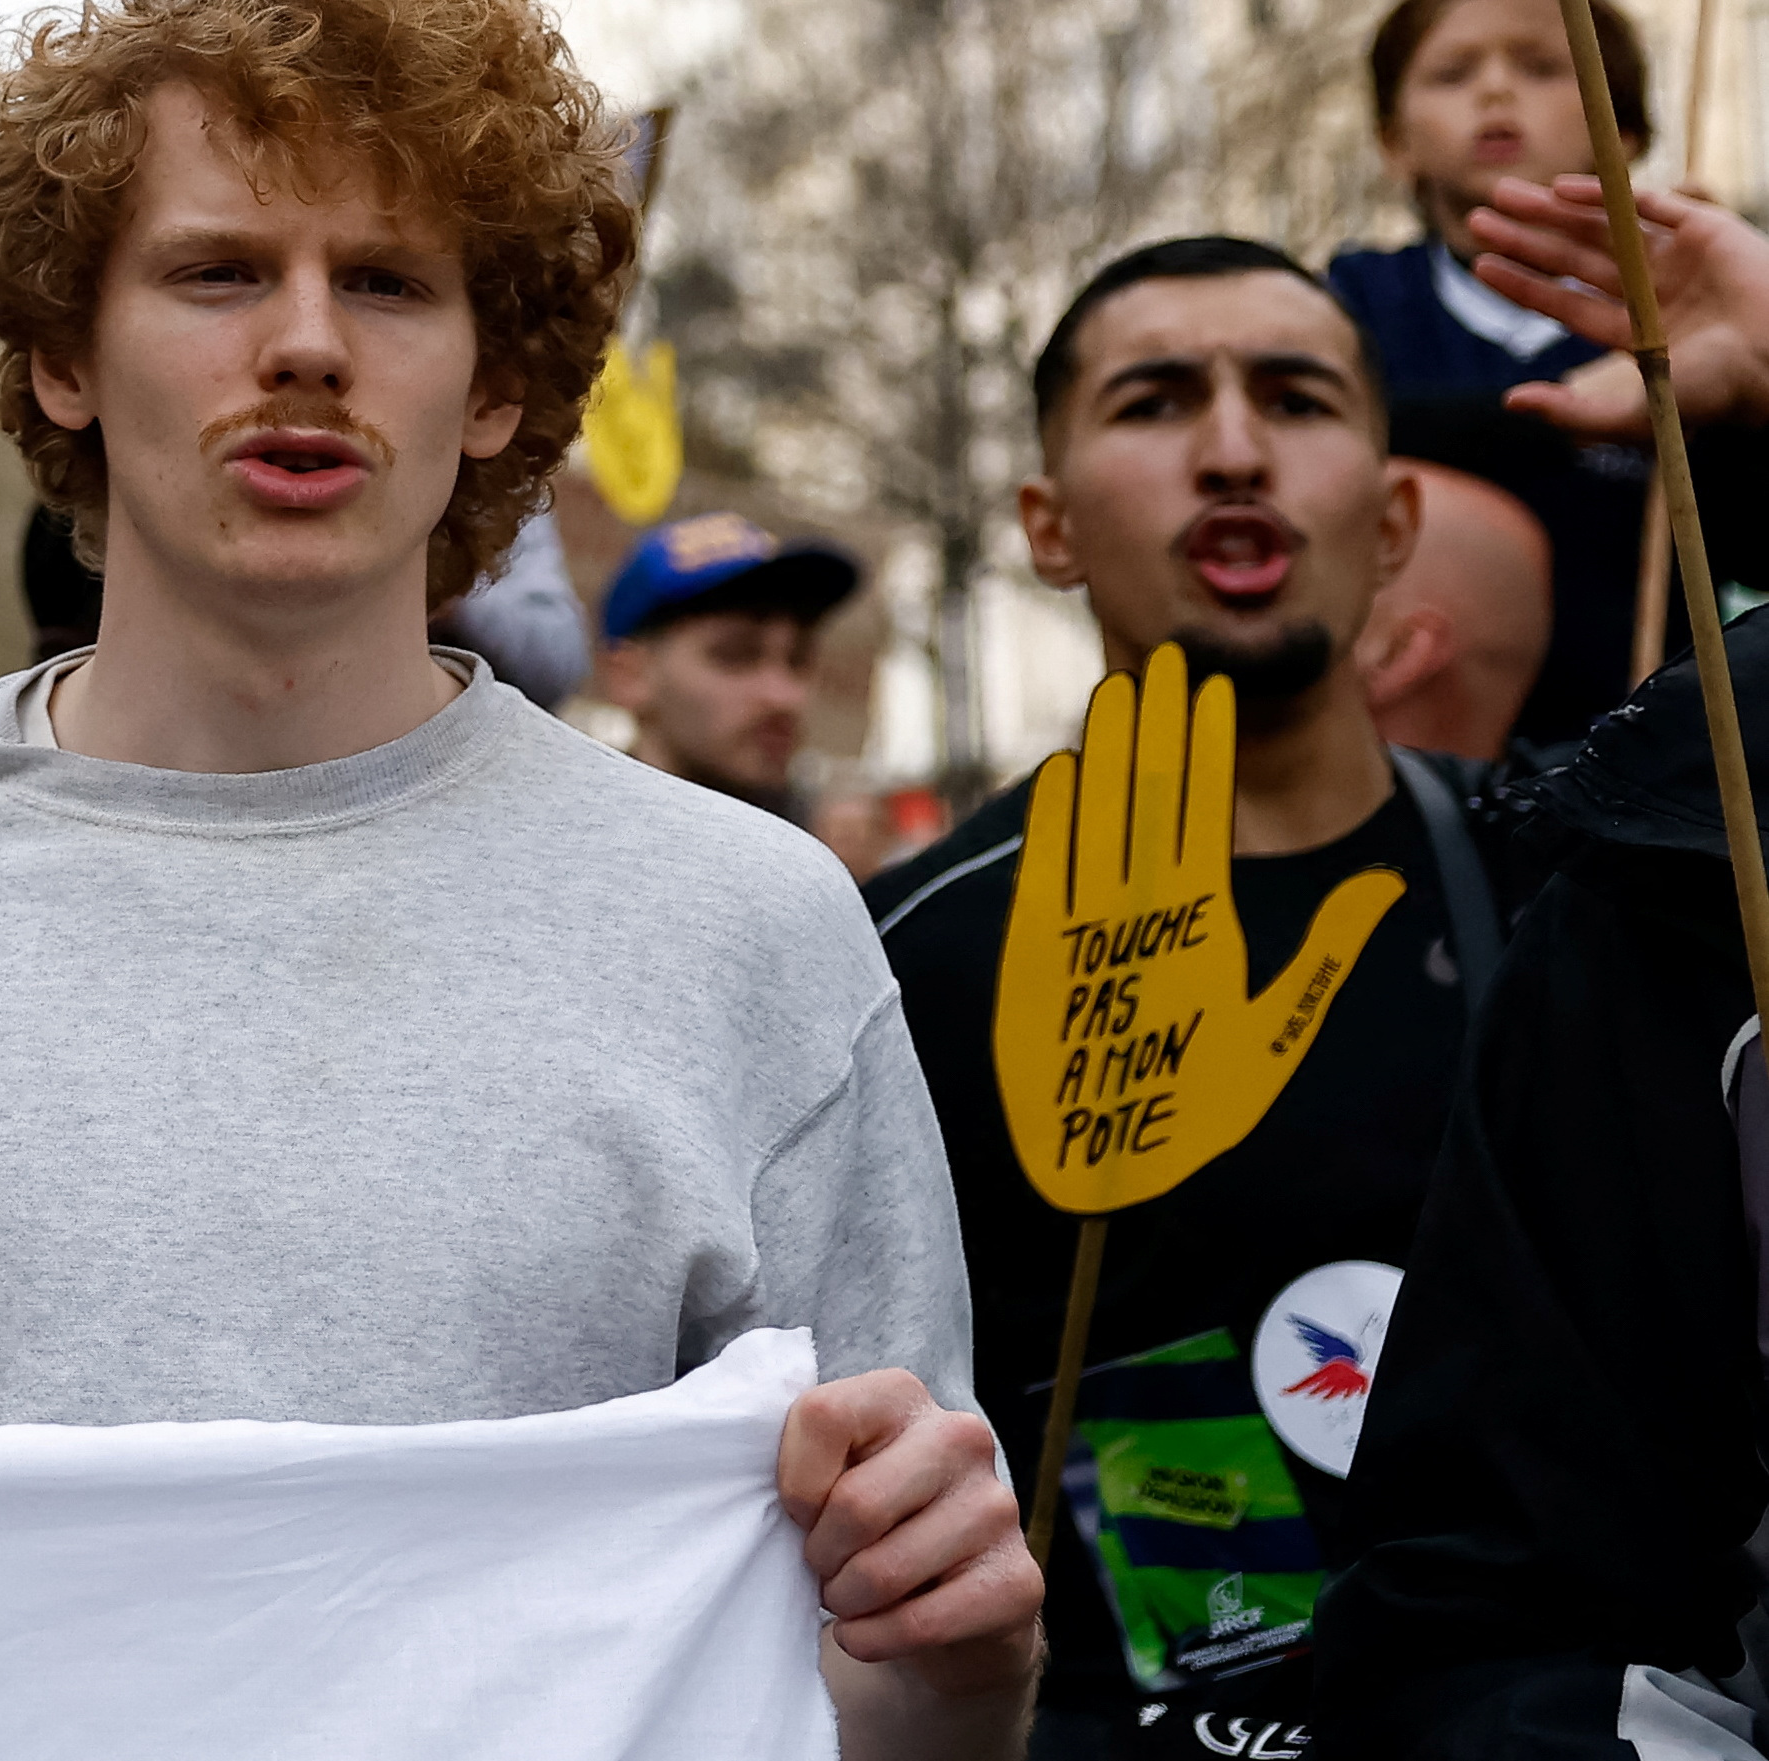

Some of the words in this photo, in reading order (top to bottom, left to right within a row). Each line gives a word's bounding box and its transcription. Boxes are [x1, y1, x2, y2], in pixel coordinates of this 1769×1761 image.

[1062, 893, 1216, 977] TOUCHE
[1061, 972, 1141, 1041] PAS
[1056, 1044, 1088, 1106] A
[1095, 1007, 1205, 1100] MON
[1057, 1091, 1178, 1171] POTE
